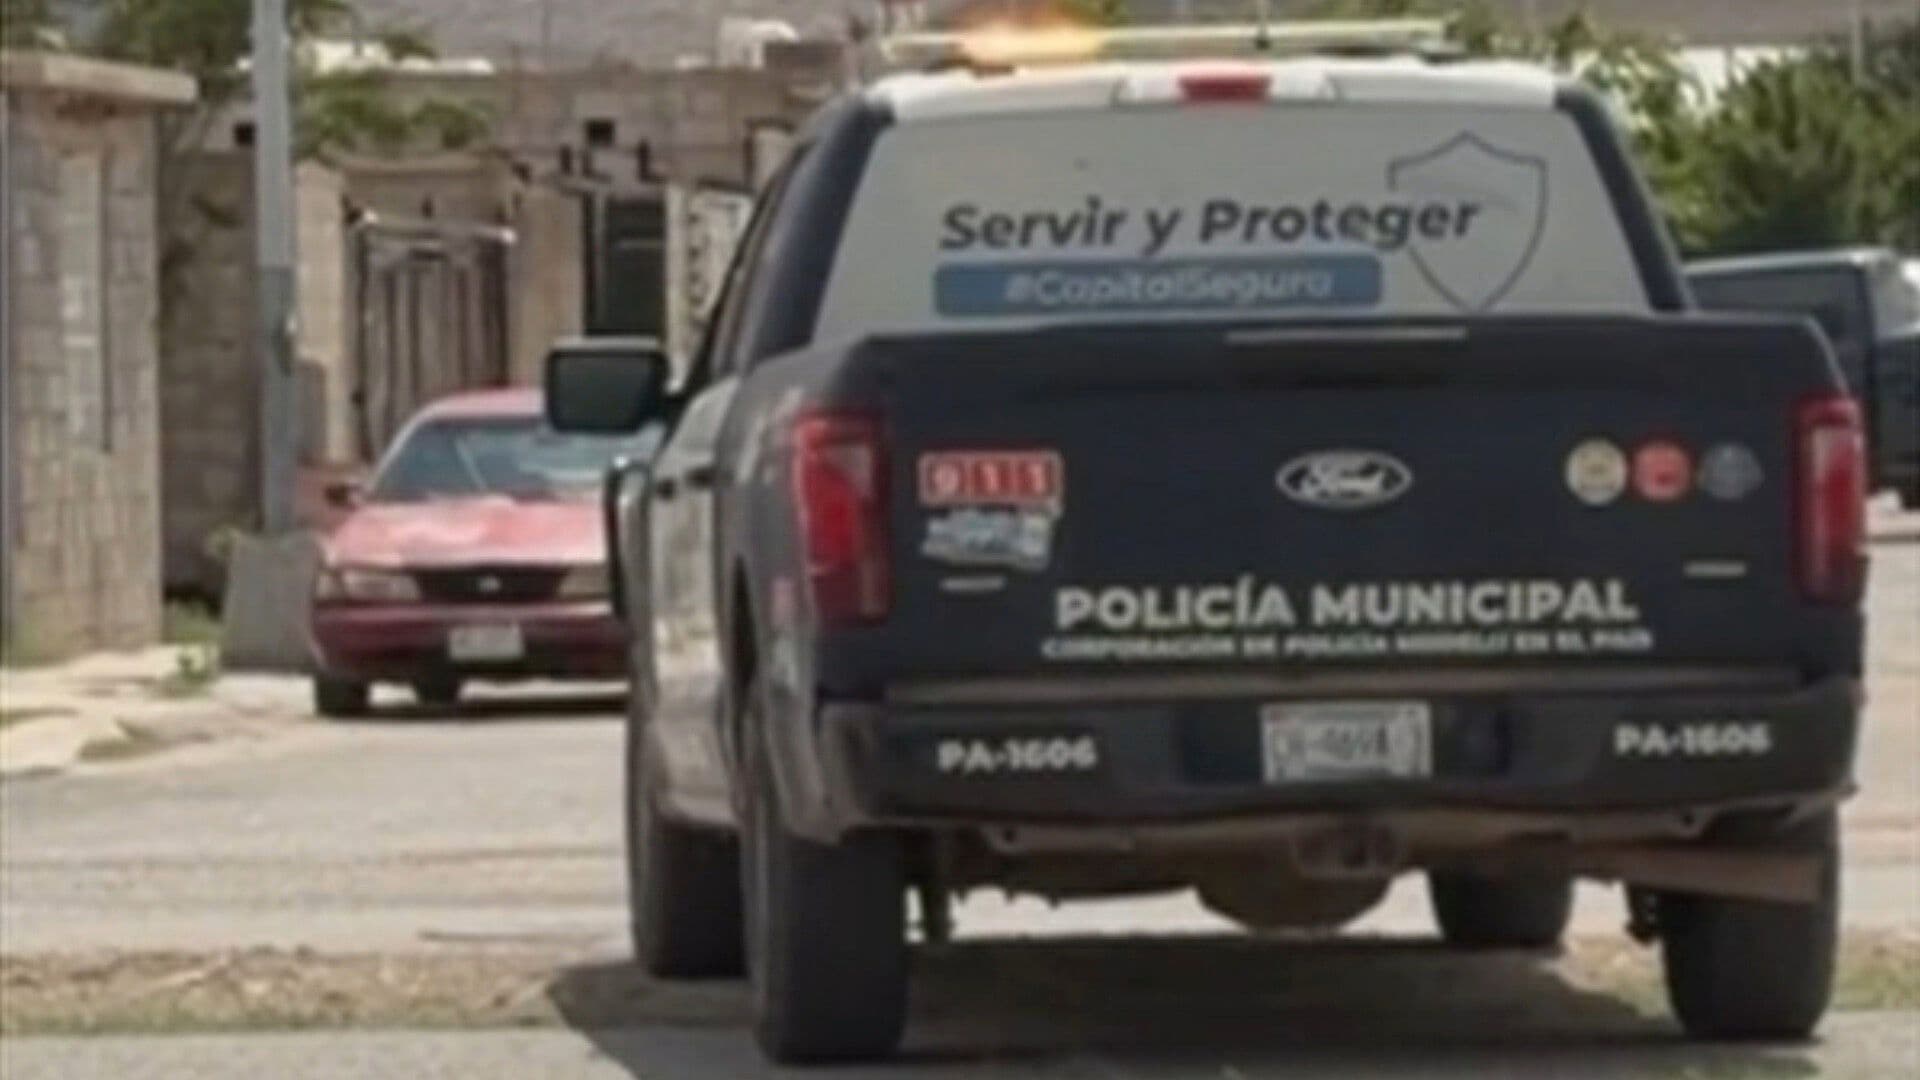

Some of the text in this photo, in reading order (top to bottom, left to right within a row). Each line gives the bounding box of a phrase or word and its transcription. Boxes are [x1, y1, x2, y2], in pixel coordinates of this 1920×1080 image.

[941, 197, 1480, 257] Servir y Proteger
[1004, 265, 1335, 308] #CapitalSegura
[933, 461, 1048, 494] 911
[1056, 574, 1640, 628] POLICÍA MUNICIPAL
[937, 737, 1097, 774] PA-1606
[1614, 720, 1772, 756] PA-1606
